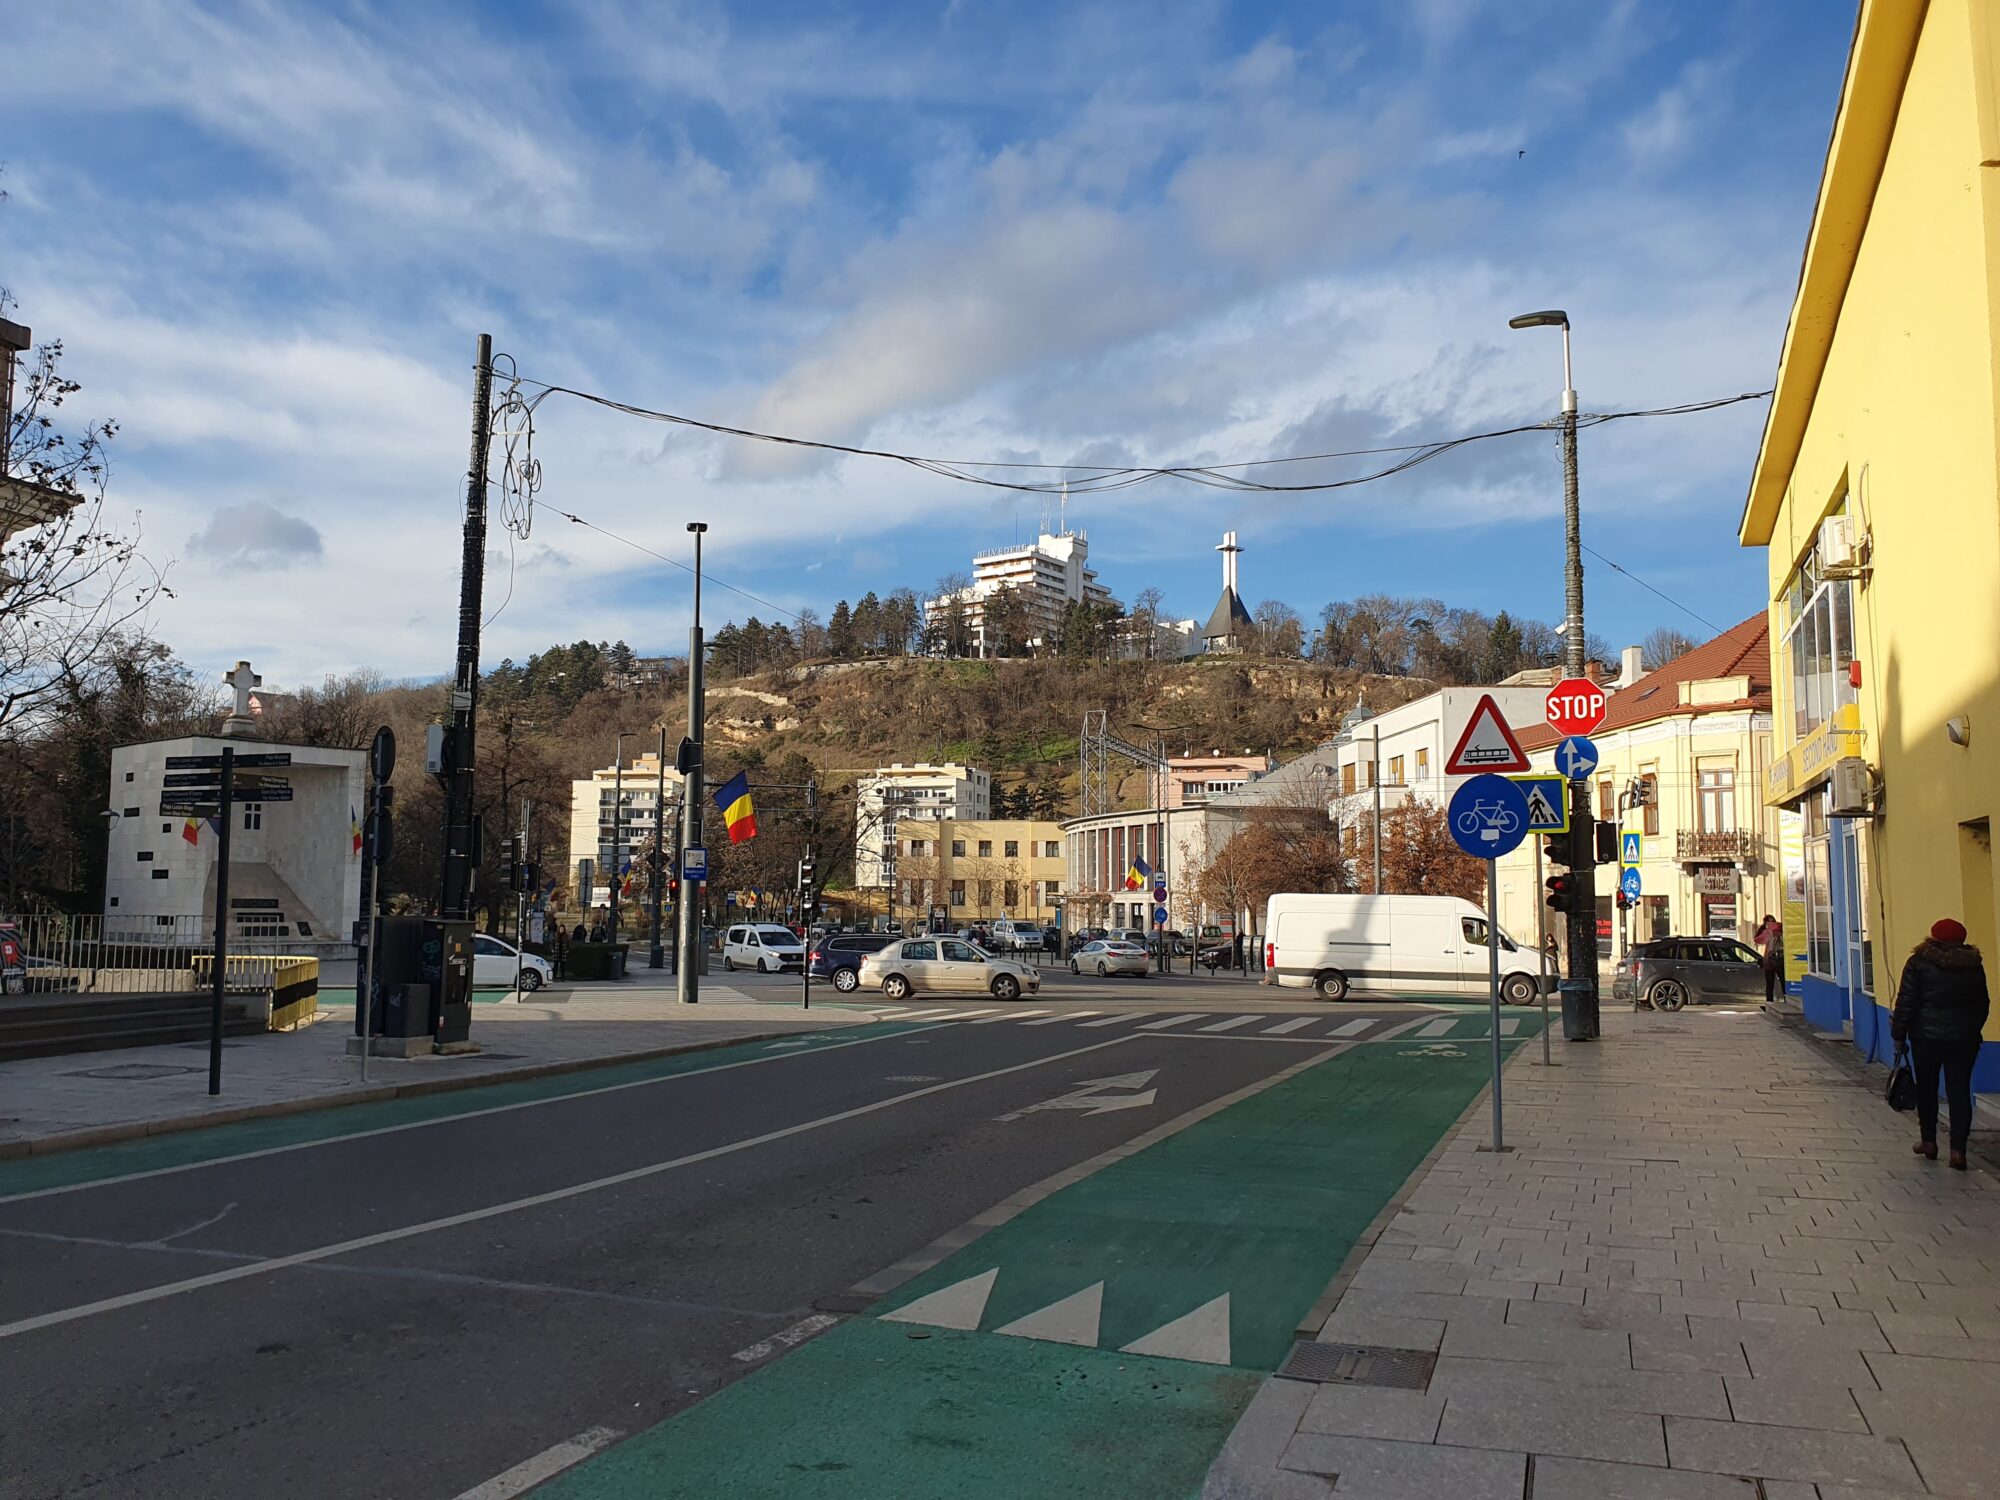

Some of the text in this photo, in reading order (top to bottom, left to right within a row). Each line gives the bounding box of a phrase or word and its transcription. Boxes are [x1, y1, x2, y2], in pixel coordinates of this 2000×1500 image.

[977, 544, 1028, 558] BELVEDERE
[1547, 694, 1604, 720] STOP
[1803, 736, 1823, 773] SECOND
[1704, 878, 1730, 890] STORE
